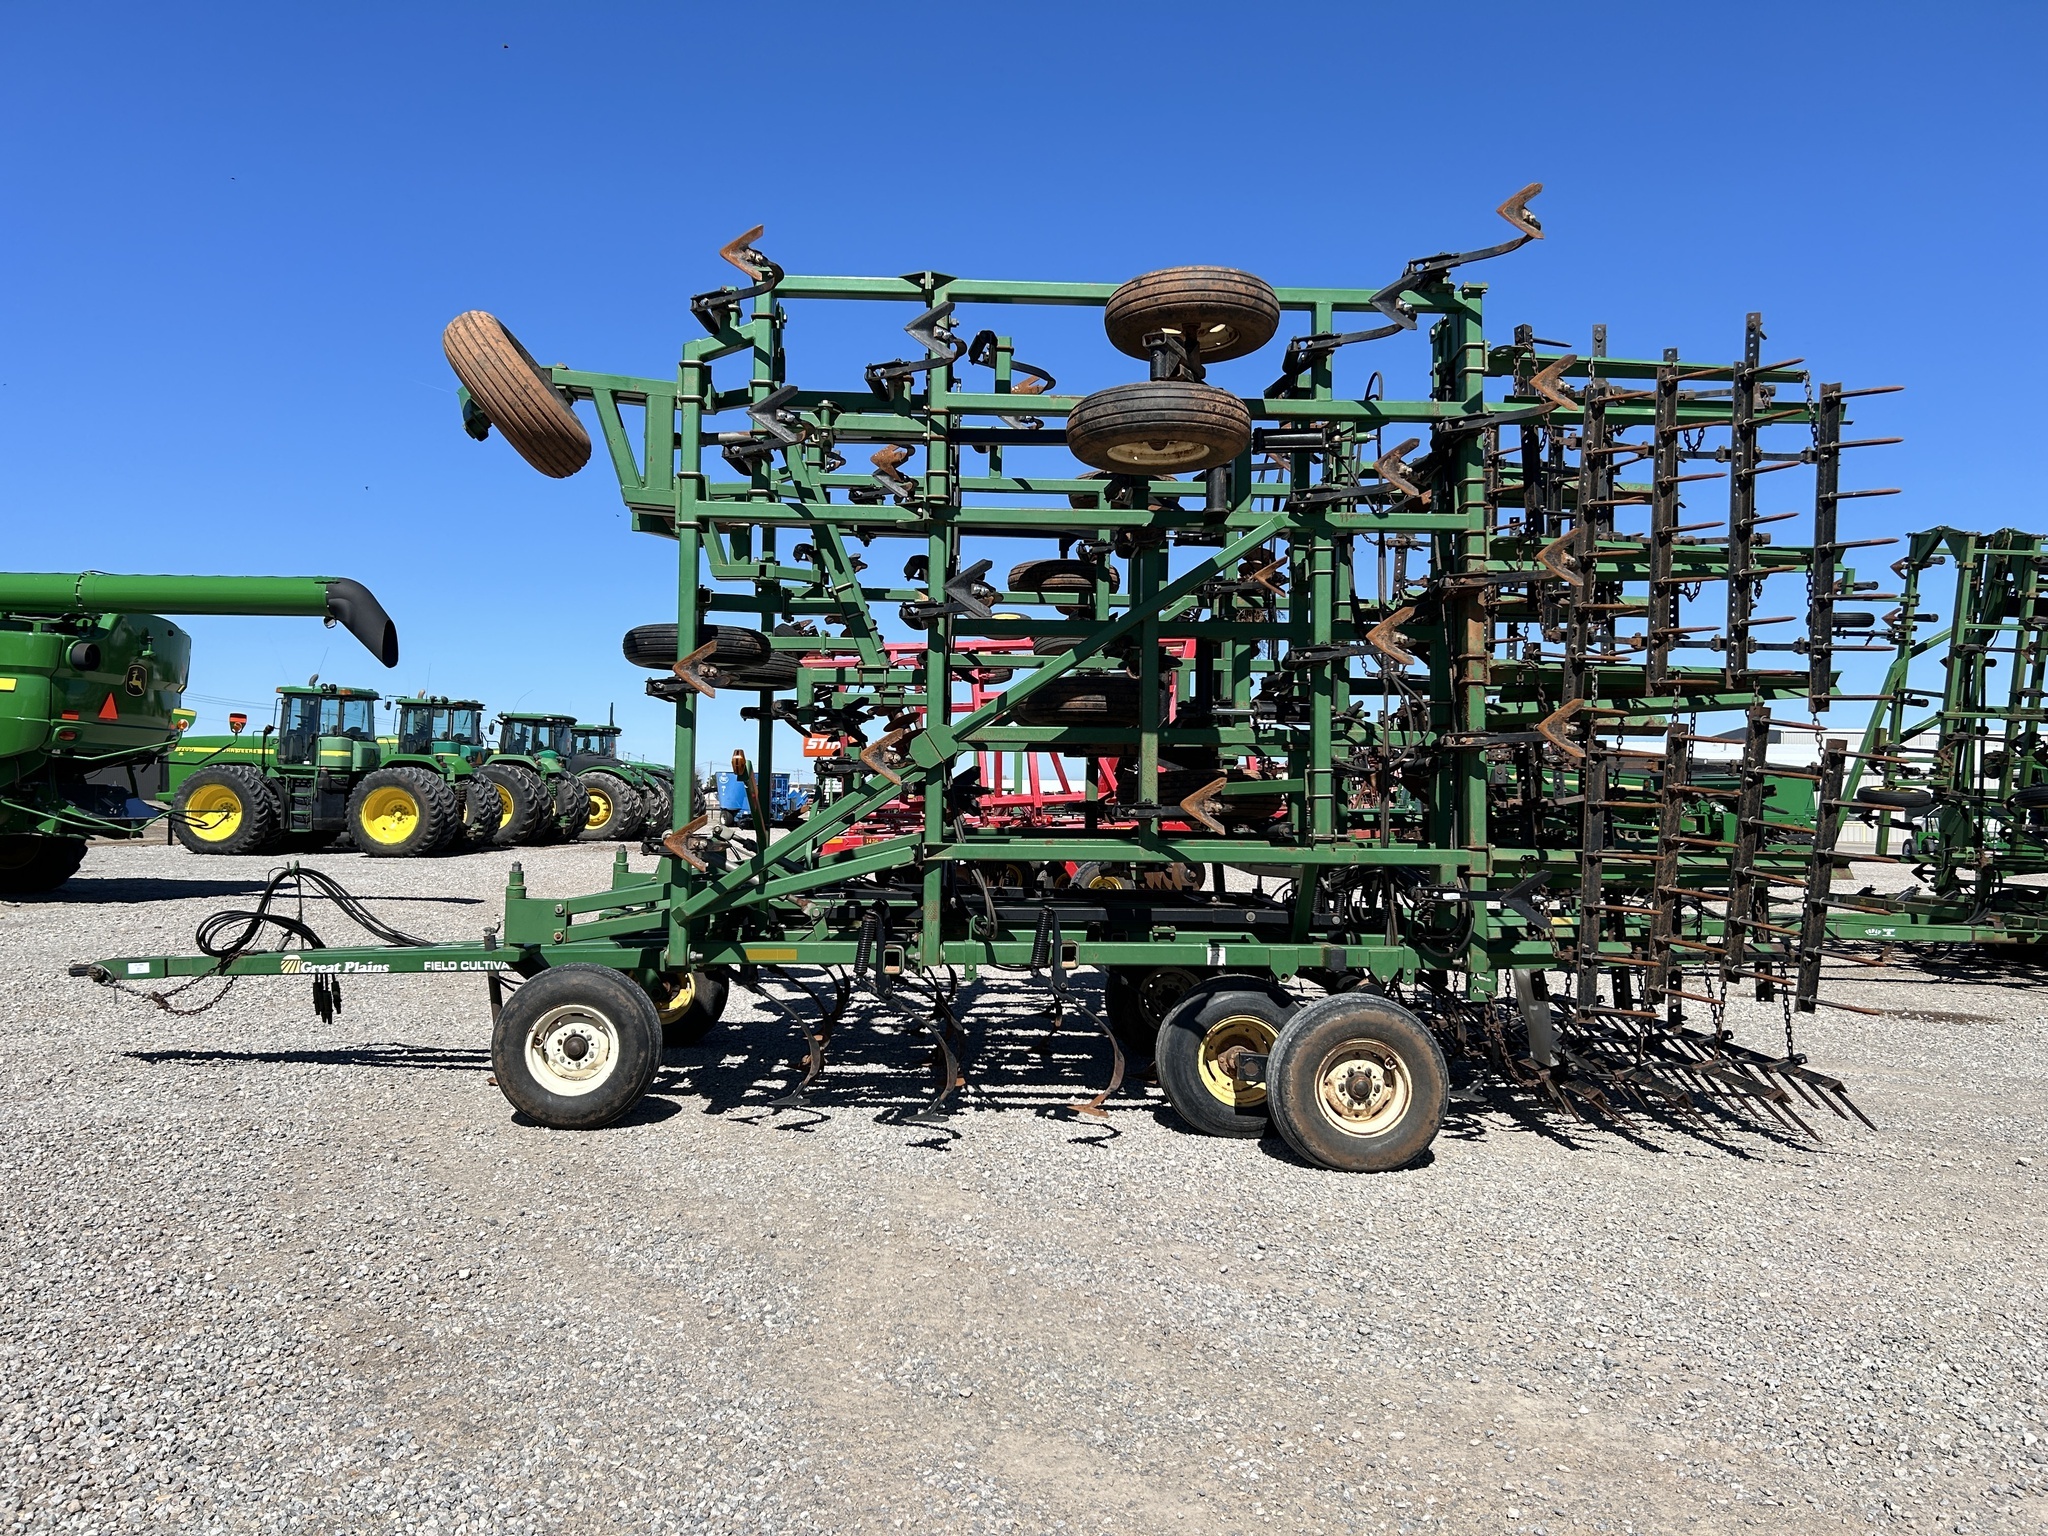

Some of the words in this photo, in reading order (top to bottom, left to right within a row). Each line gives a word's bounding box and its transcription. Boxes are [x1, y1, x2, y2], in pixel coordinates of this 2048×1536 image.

[805, 738, 842, 750] STIH
[301, 961, 341, 973] Great
[343, 961, 390, 973] Plains
[423, 961, 457, 971] FIELD
[460, 961, 512, 970] CULTIVA
